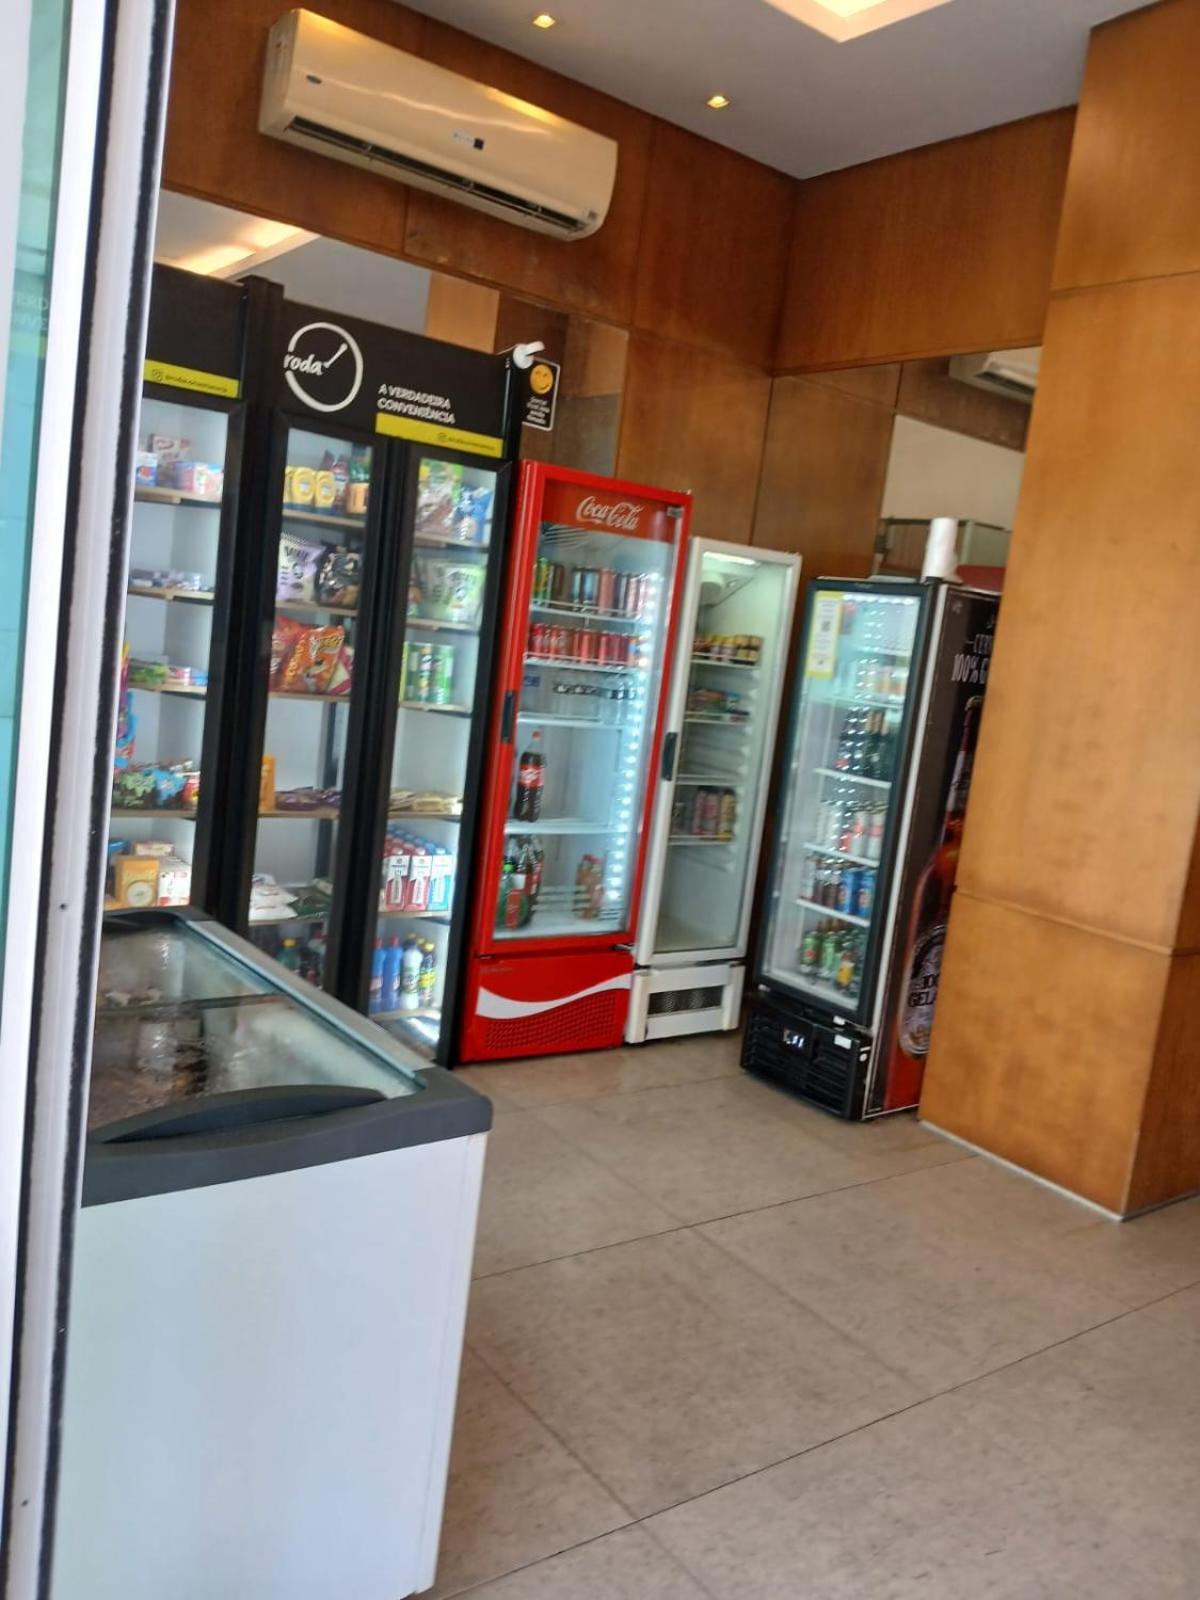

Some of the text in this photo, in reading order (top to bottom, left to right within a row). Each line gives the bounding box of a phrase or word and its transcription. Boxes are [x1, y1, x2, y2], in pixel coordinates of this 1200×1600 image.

[283, 354, 323, 376] roda
[378, 383, 452, 410] A VERDADEIRA
[377, 397, 456, 425] CONVENIÊNCIA
[576, 495, 646, 531] Coca-Cola
